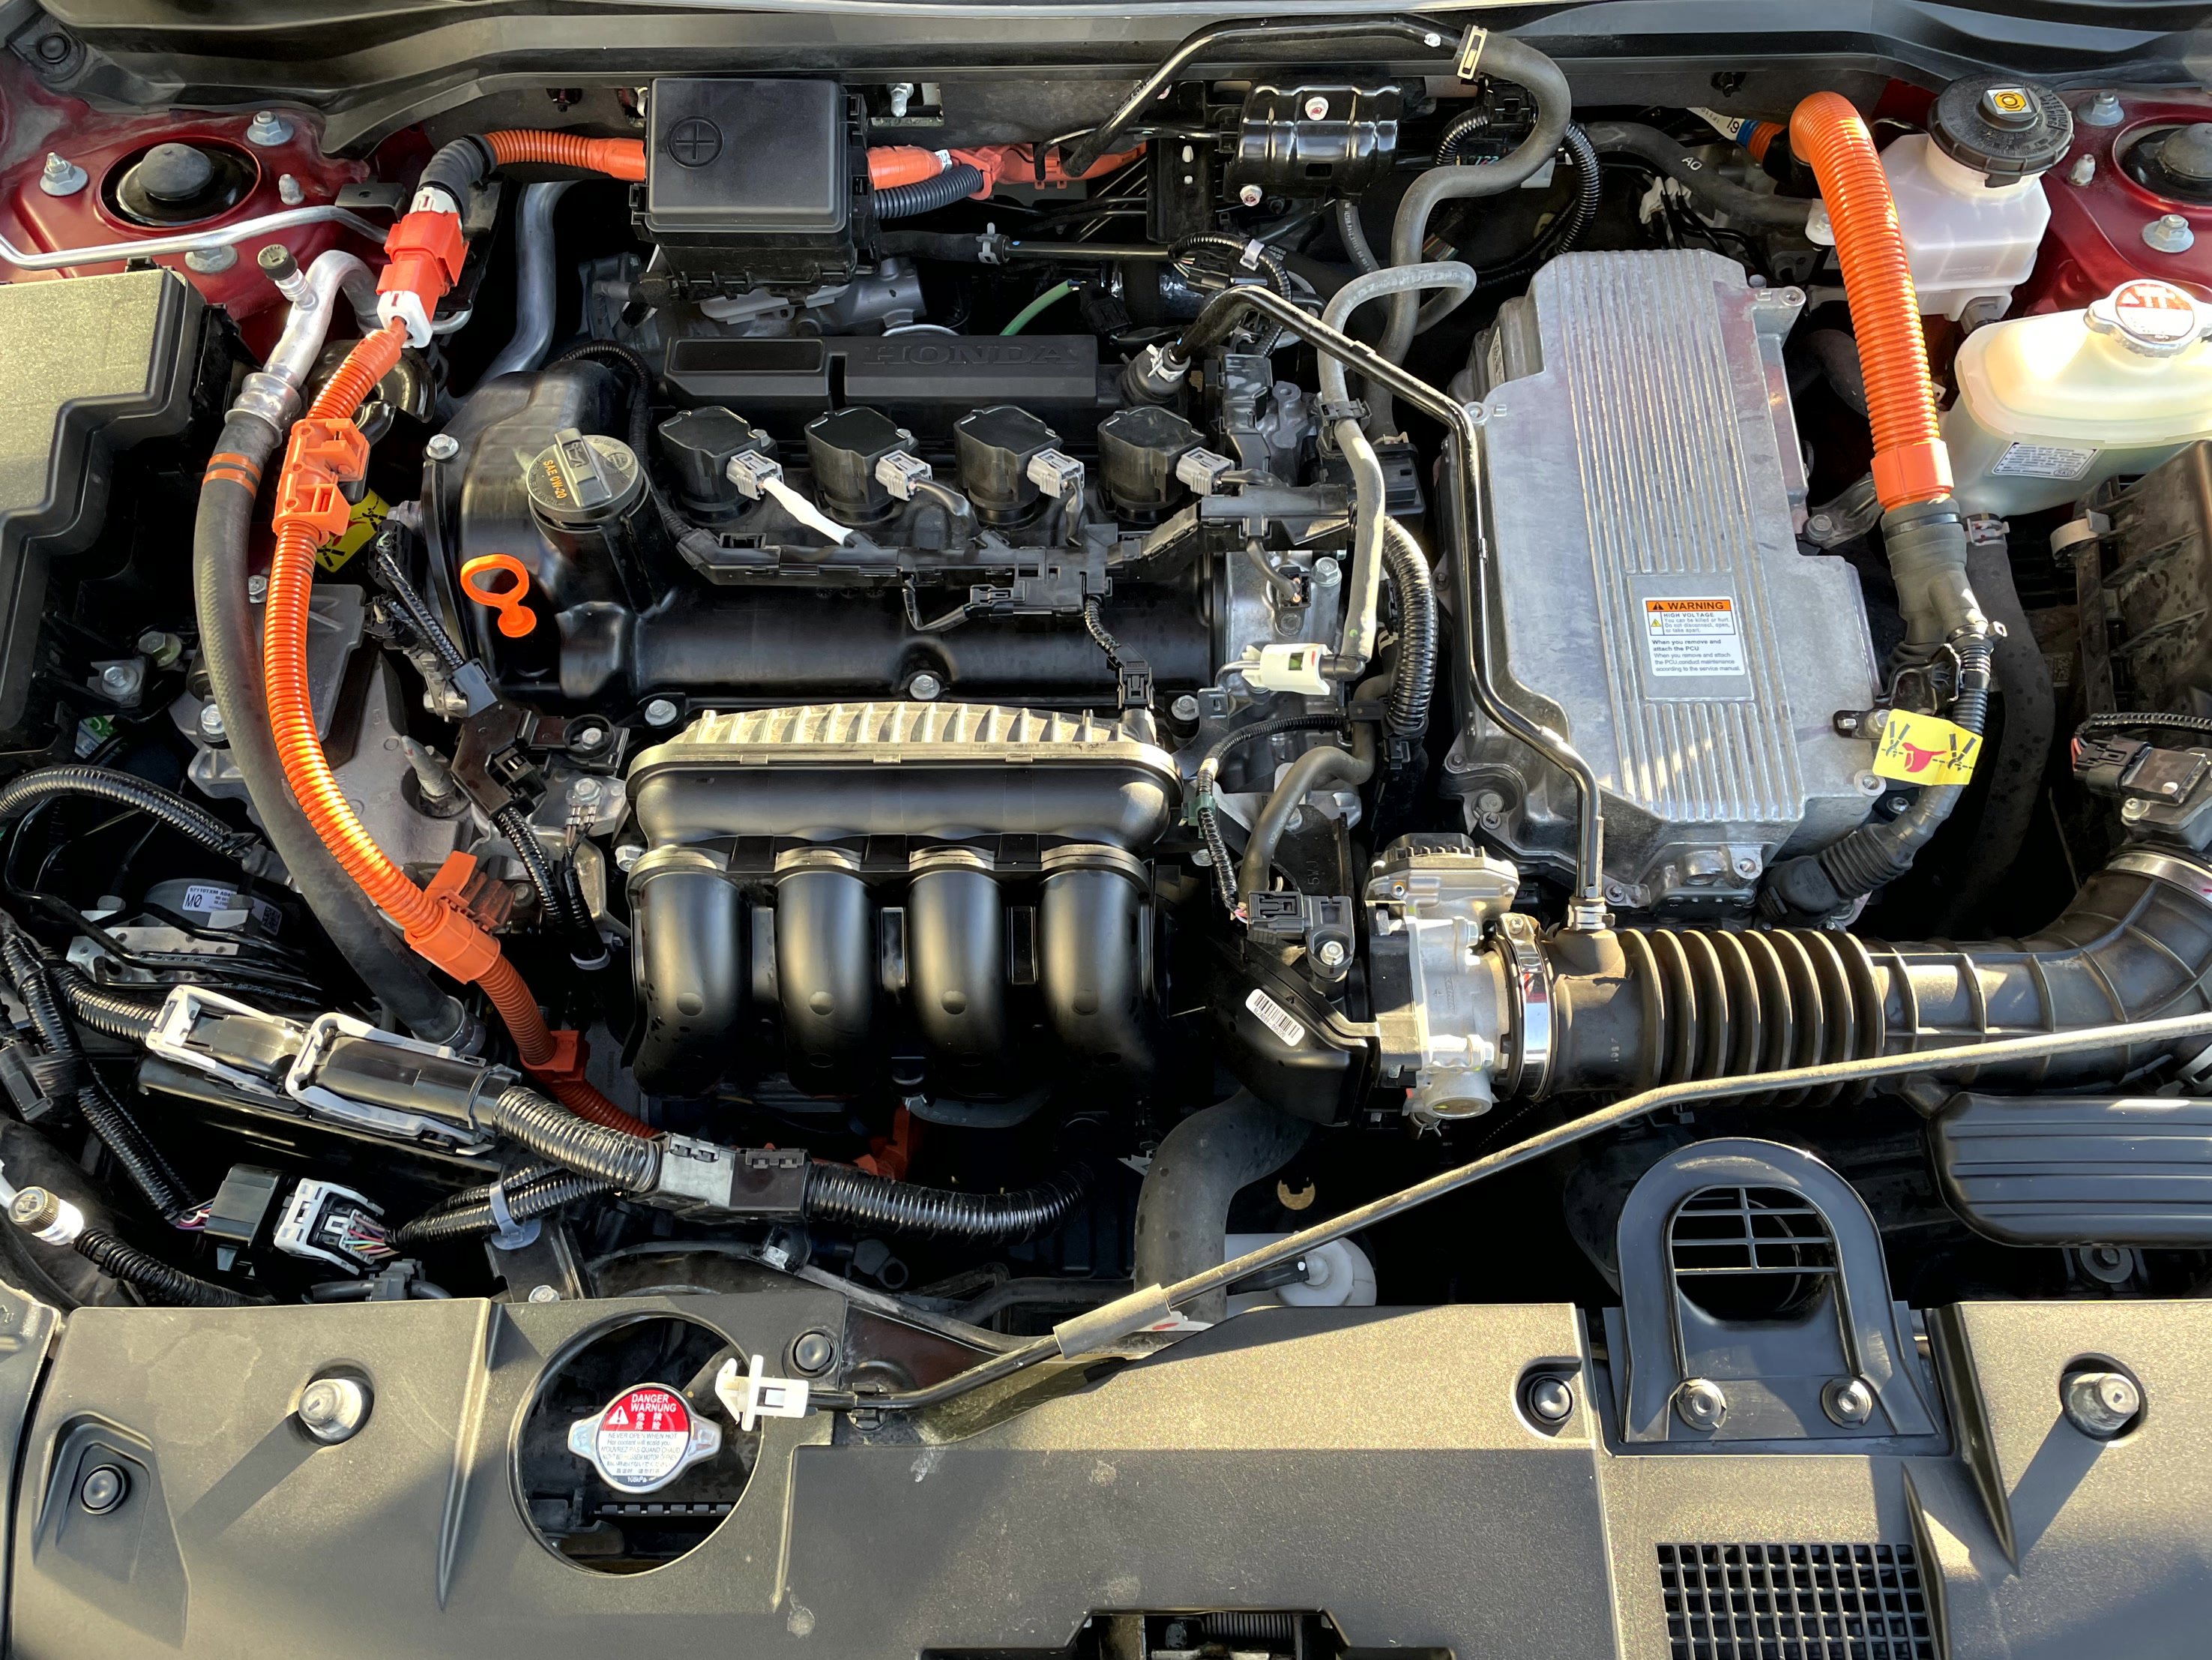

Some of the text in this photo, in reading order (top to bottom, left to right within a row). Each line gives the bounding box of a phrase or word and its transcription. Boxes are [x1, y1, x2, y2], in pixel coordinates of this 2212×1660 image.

[863, 343, 1079, 366] HONDA
[543, 459, 558, 477] SAE
[549, 475, 567, 499] 0W-20
[1668, 602, 1723, 610] WARNING
[1306, 860, 1321, 885] 5WJ
[631, 1393, 669, 1404] DANGER
[630, 1403, 677, 1413] WARNUNG
